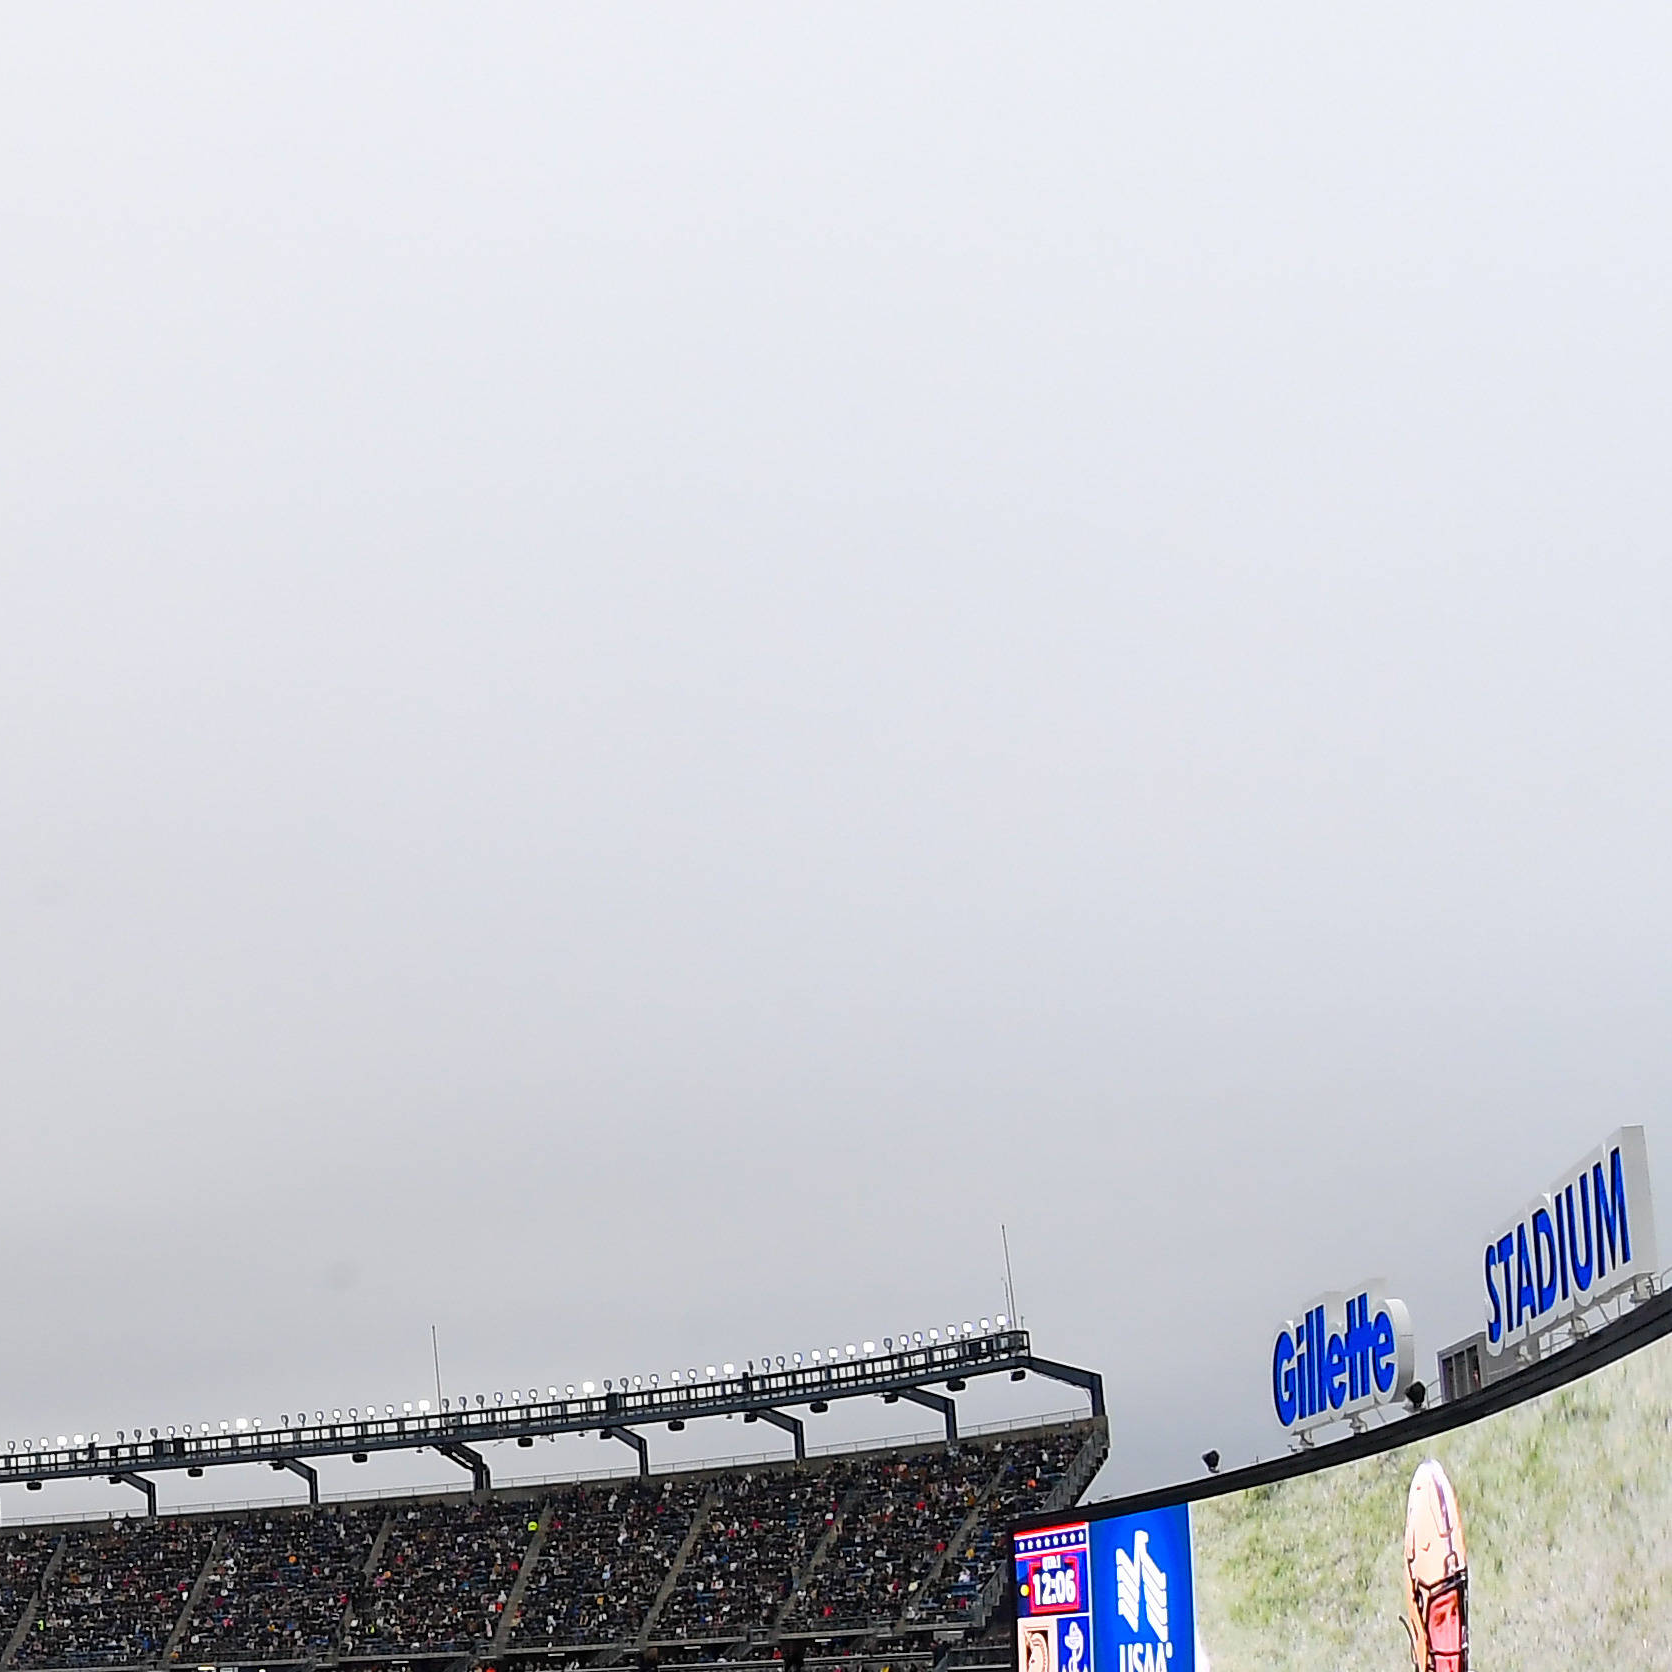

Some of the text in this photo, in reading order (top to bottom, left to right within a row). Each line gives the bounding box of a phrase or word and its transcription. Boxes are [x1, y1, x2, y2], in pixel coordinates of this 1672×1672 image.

[1484, 1146, 1632, 1345] STADIUM
[1273, 1291, 1397, 1428] Gillette
[1033, 1570, 1076, 1605] 12:06
